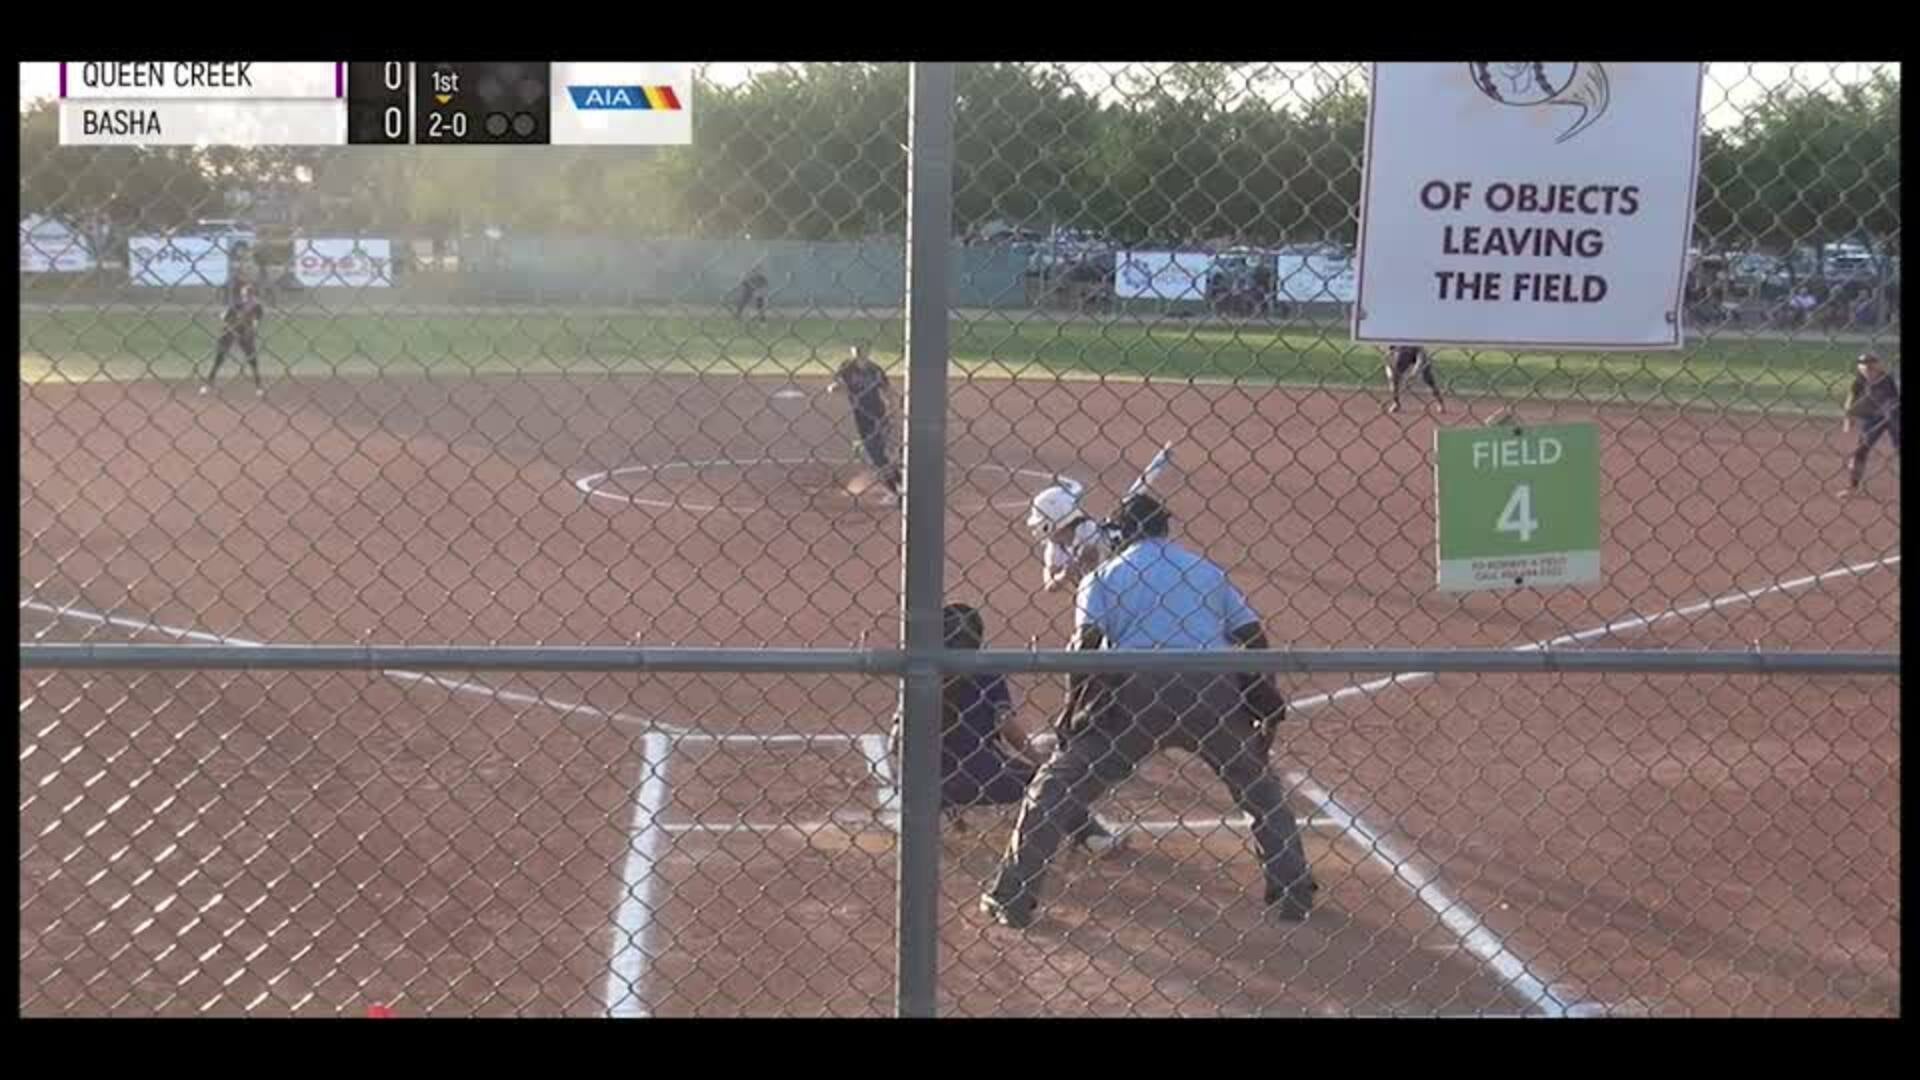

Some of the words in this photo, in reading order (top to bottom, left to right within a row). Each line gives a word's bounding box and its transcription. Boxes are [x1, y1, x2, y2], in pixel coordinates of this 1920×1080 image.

[1420, 180, 1472, 211] OF
[1484, 182, 1640, 216] OBJECTS
[1442, 225, 1605, 259] LEAVING
[1434, 271, 1502, 301] THE
[1512, 272, 1608, 304] FIELD
[1472, 438, 1563, 470] FIELD
[1495, 484, 1539, 542] 4
